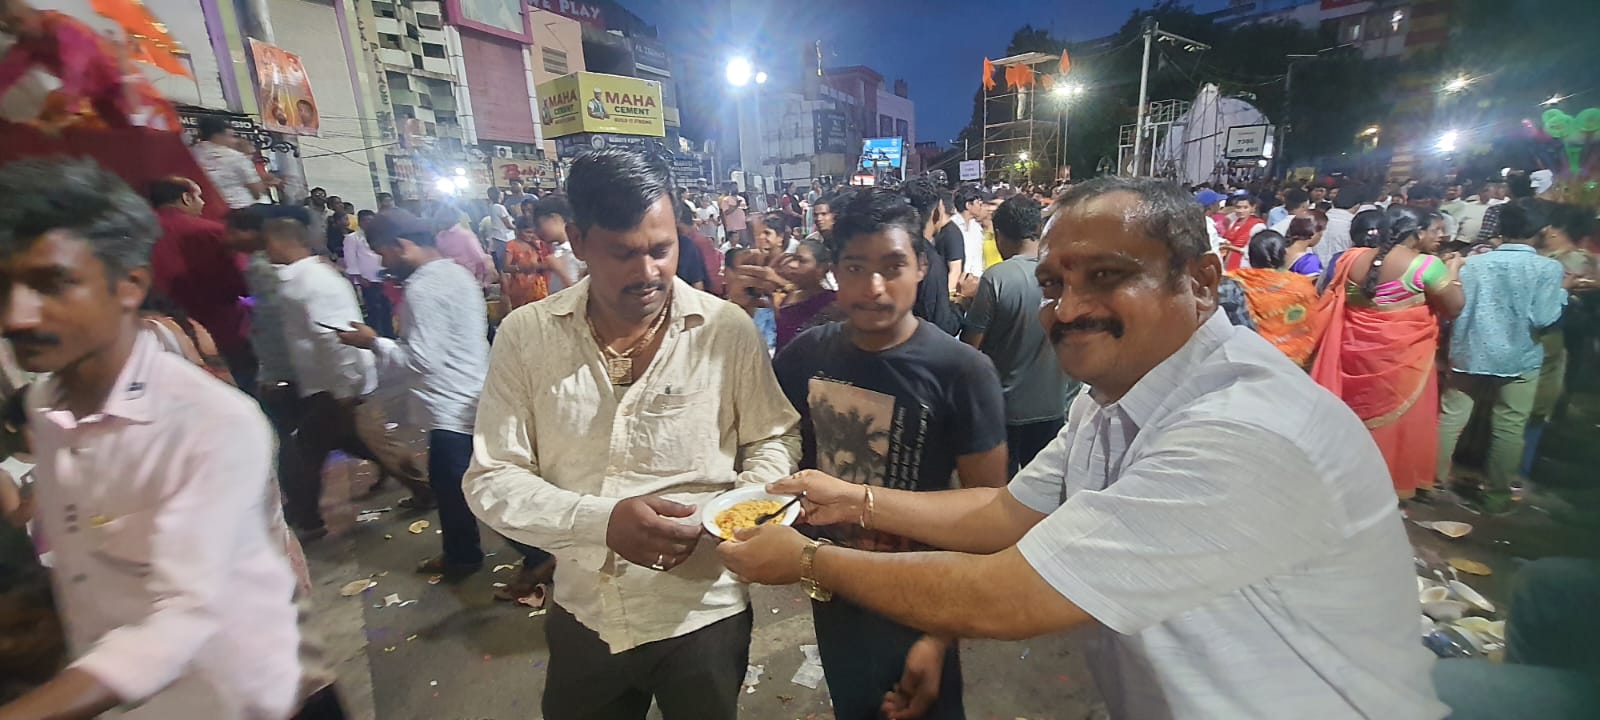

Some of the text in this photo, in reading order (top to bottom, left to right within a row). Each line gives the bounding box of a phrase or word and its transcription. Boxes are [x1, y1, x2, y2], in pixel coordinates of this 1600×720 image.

[559, 0, 600, 19] PLAY
[369, 41, 389, 105] PALACE
[548, 90, 578, 107] MAHA
[604, 91, 656, 108] MAHA
[614, 106, 650, 116] CEMENT
